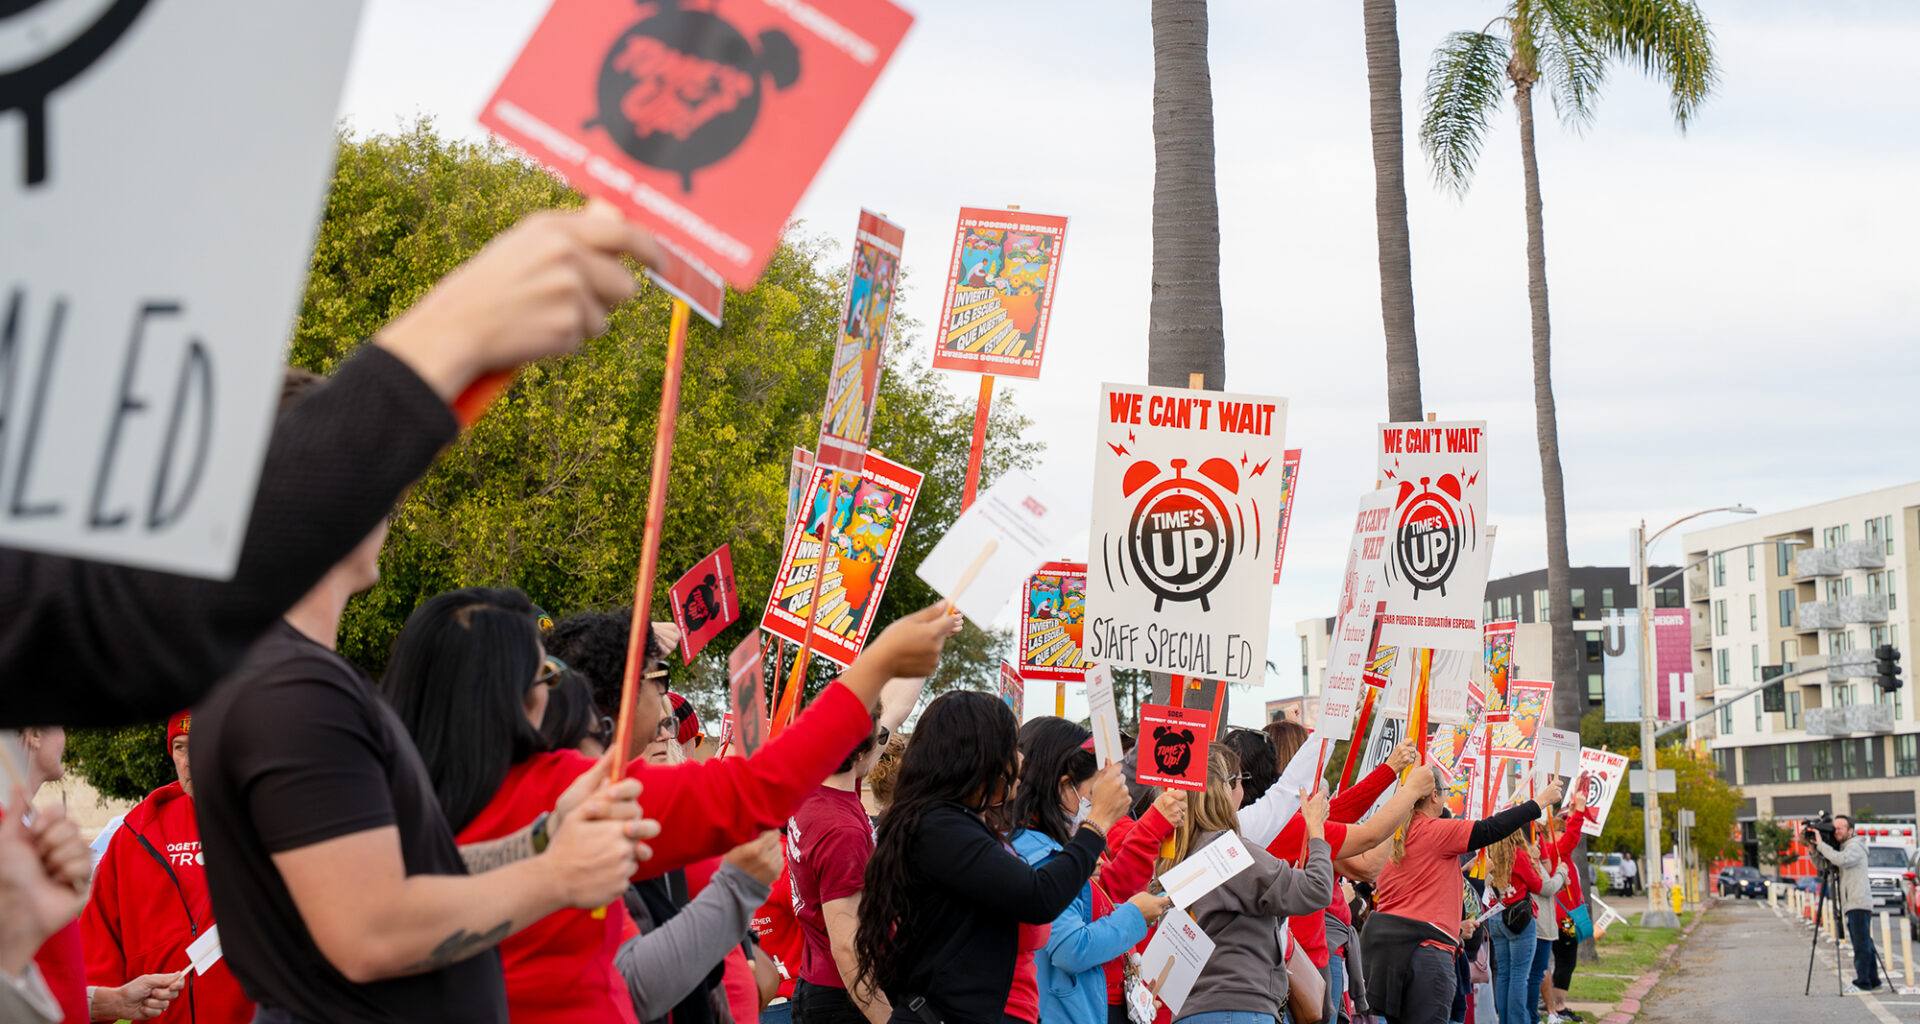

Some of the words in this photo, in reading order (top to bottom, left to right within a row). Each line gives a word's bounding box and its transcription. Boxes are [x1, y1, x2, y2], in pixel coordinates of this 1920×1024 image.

[965, 218, 977, 226] NO
[978, 219, 1018, 230] PODEMOS
[1019, 224, 1057, 234] ESPERAR
[950, 310, 970, 332] LAS
[957, 328, 977, 351] QUE
[82, 299, 216, 532] ED
[1110, 392, 1143, 425] WE
[1149, 396, 1211, 430] CAN'T
[1218, 401, 1275, 436] WAIT
[1384, 429, 1402, 453] WE
[1406, 428, 1442, 453] CAN'T
[1446, 428, 1480, 453] WAIT
[1151, 509, 1205, 530] TIME'S
[1364, 508, 1390, 531] CAN'T
[1410, 516, 1442, 534] TIME'S
[1152, 529, 1214, 577] UP
[1362, 536, 1385, 560] WAIT
[1411, 531, 1448, 572] UP
[786, 566, 808, 587] LAS
[1364, 576, 1376, 593] for
[691, 588, 709, 617] TIME'S
[789, 588, 812, 613] QUE
[1358, 600, 1370, 617] the
[1382, 615, 1395, 624] ENAR
[1396, 616, 1417, 626] PUESTOS
[1418, 617, 1424, 626] DE
[1453, 619, 1476, 630] ESPECIAL
[1655, 615, 1684, 626] HEIGHTS
[811, 625, 844, 645] PODEMO
[1344, 624, 1366, 642] future
[1029, 636, 1043, 652] LAS
[1091, 617, 1139, 662] STAFF
[1146, 623, 1217, 674] SPECIAL
[1226, 635, 1252, 679] ED
[1036, 649, 1050, 665] QUE
[1348, 651, 1361, 666] our
[1328, 672, 1355, 692] students
[1669, 673, 1695, 721] H
[1158, 743, 1186, 756] TIME'S
[1581, 750, 1591, 759] WE
[1590, 751, 1606, 763] CAN'T
[1606, 756, 1623, 768] WAIT
[167, 842, 201, 852] OGET
[751, 916, 771, 925] ETHER
